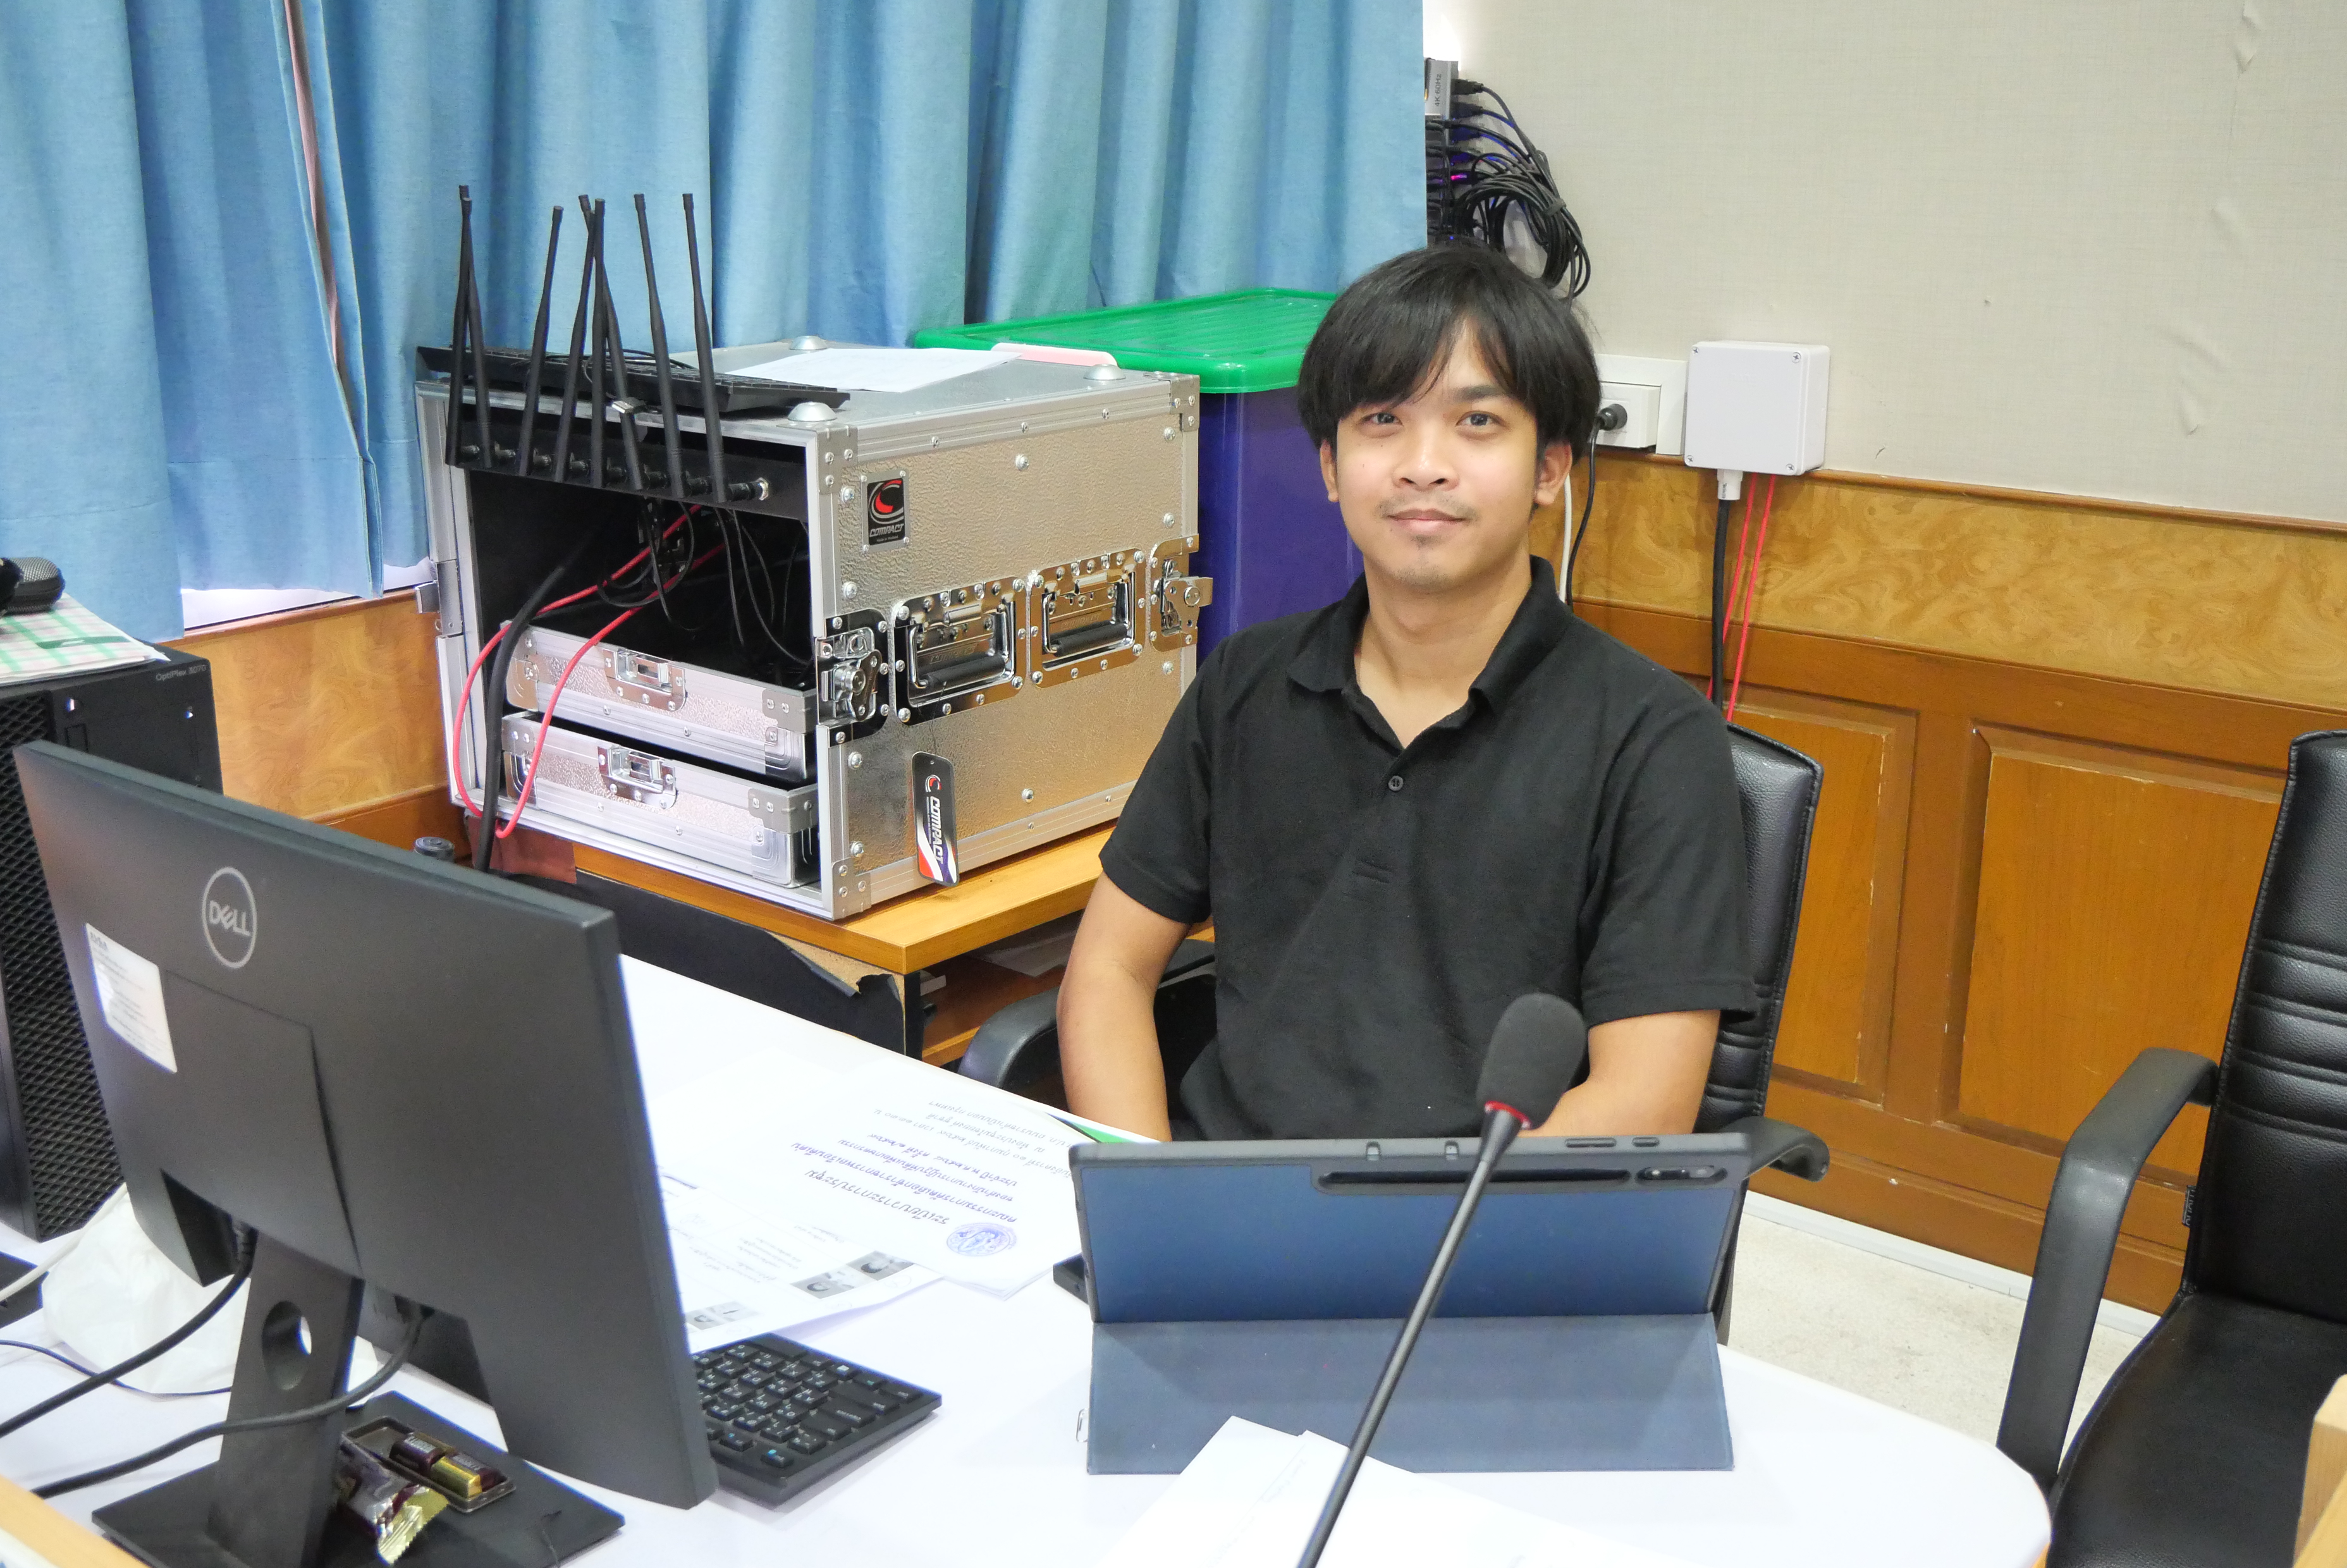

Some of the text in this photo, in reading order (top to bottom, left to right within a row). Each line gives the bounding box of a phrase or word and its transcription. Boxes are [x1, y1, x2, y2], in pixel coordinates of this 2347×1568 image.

[869, 524, 904, 537] COMPACT
[156, 665, 206, 682] OptiPlex 3070
[930, 796, 943, 864] COMPACT
[209, 900, 251, 937] DELL
[928, 1101, 967, 1114] กรุงเทพฯ
[912, 1122, 935, 1132] เวลา
[925, 1113, 954, 1124] ชูชาติ
[966, 1112, 1046, 1139] ถนนราชดำเนินนอก
[900, 1146, 931, 1158] ครั้งที่
[962, 1139, 1011, 1156] กุมภาพันธ์
[836, 1139, 1014, 1202] ของสำนักงานการปฏิรูปที่ดินเพื่อเกษตรกรรม
[979, 1171, 1018, 1187] ประจำปี
[790, 1142, 1018, 1223] คณะกรรมการคัดเลือกข้าราชการพลเรือนดีเด่น
[804, 1169, 950, 1225] ระเบียบวาระการประชุม
